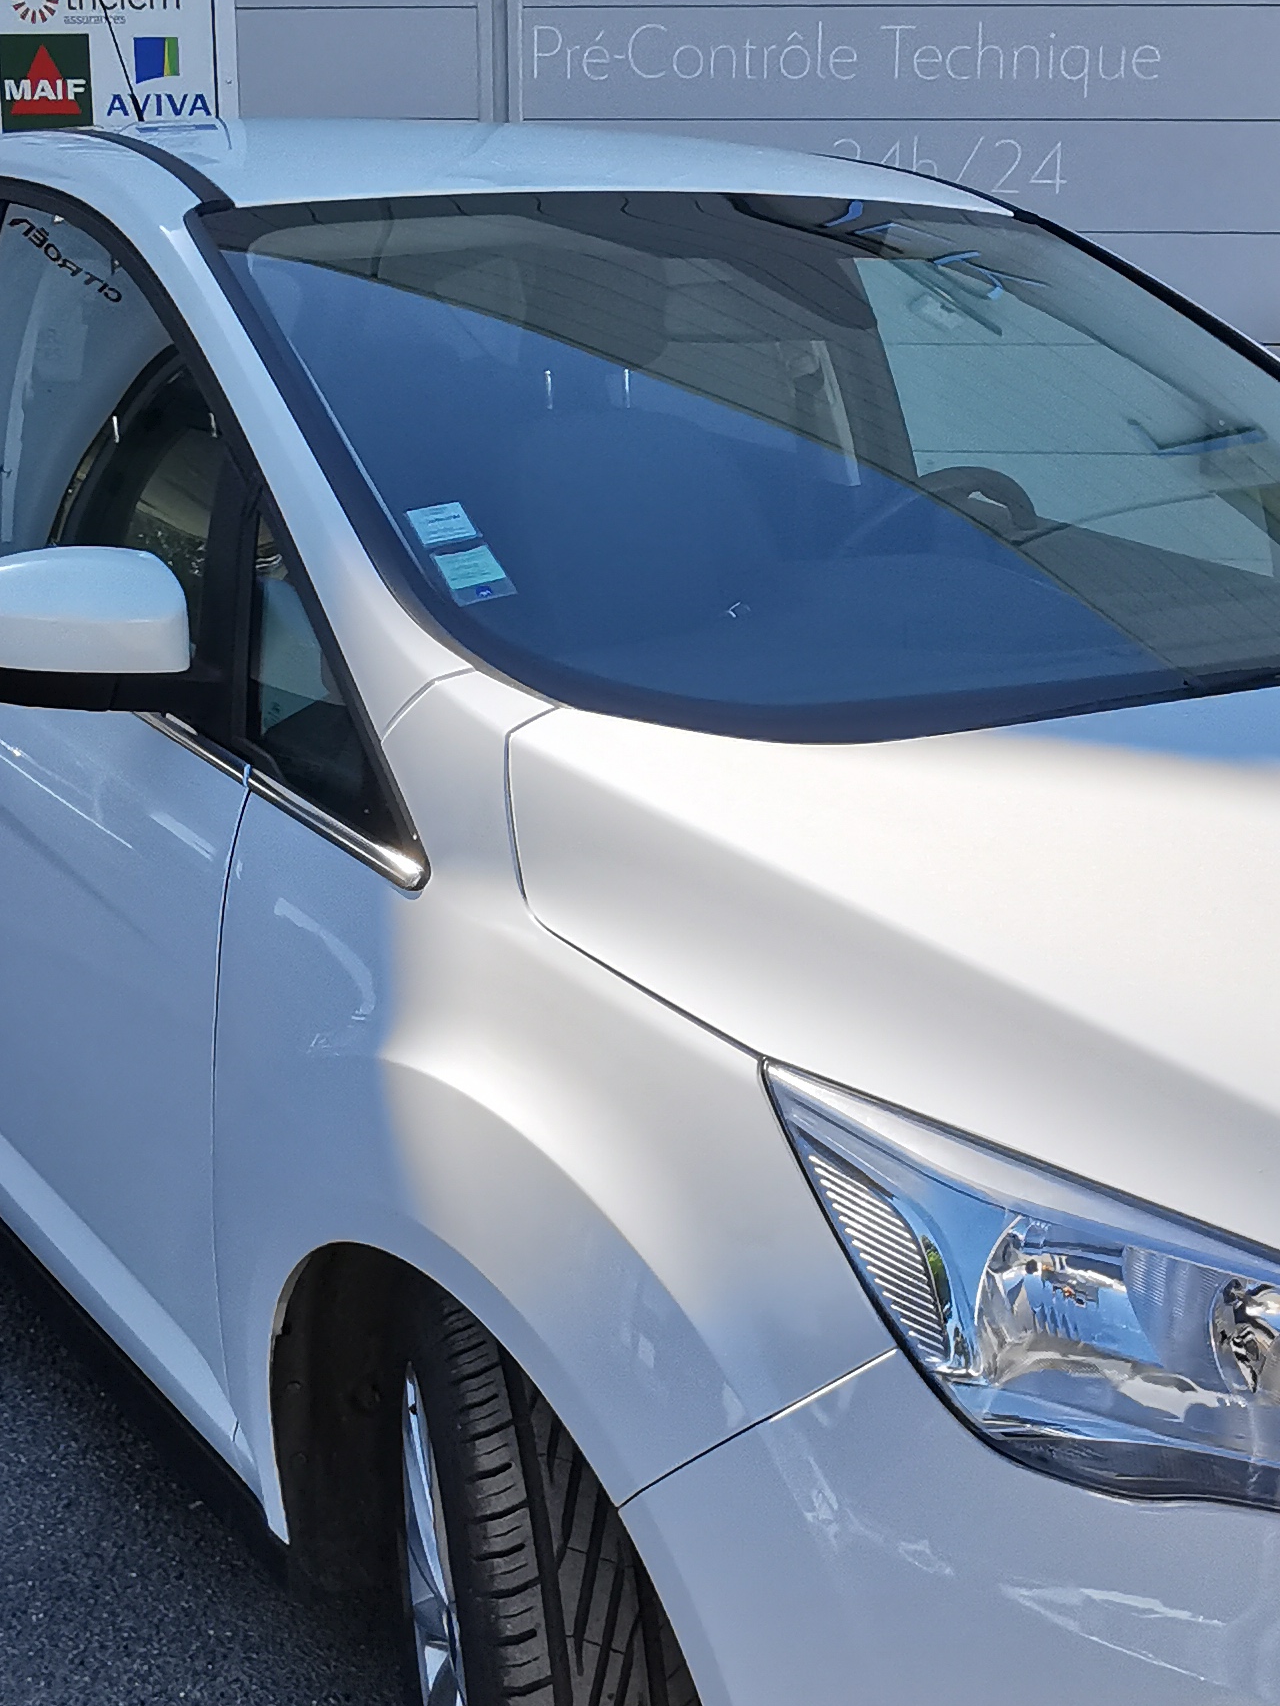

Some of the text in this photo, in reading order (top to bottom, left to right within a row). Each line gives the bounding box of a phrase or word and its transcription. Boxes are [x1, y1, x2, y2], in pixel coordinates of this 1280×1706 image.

[530, 20, 1162, 99] Pré-Contrôle Technique
[3, 78, 87, 102] MAIF
[106, 93, 213, 117] AVIVA
